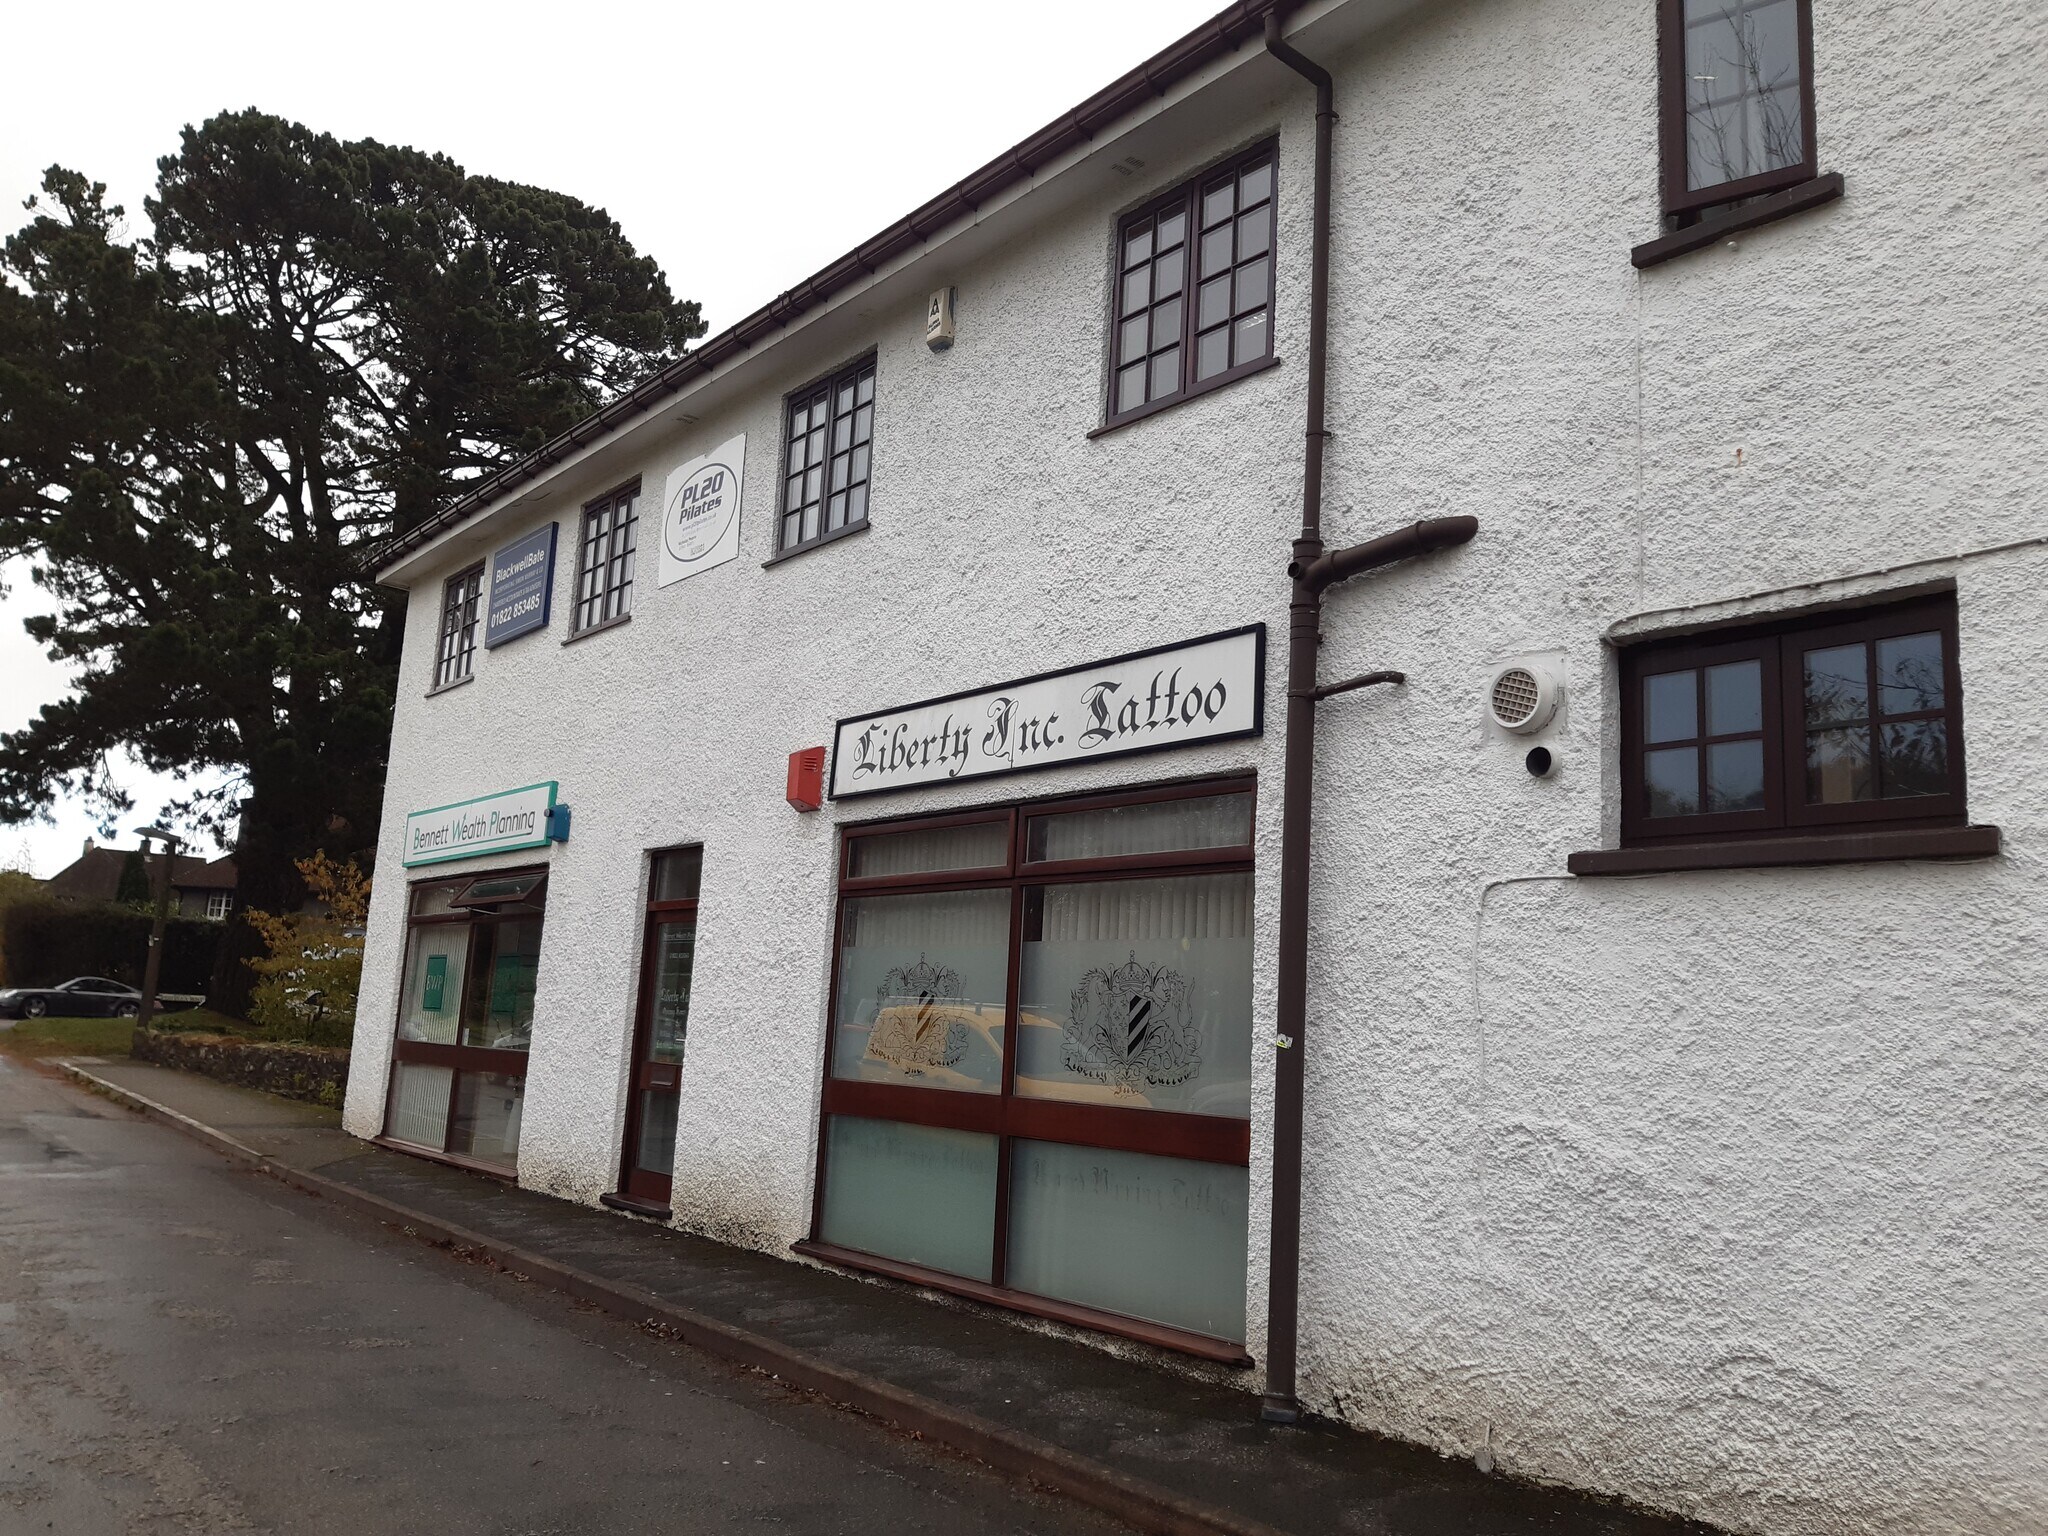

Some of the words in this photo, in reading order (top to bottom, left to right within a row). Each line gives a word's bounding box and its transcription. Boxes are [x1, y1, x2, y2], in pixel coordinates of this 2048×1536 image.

[681, 470, 724, 509] PL20
[679, 495, 722, 525] Pilates
[495, 549, 545, 583] BlackwellBate
[491, 606, 511, 628] 01822
[513, 593, 540, 618] 853485
[852, 713, 972, 780] Liberty
[982, 697, 1063, 768] Inc.
[1078, 666, 1227, 749] Tattoo
[413, 827, 449, 850] Bennett
[451, 813, 487, 842] Wealth
[489, 806, 536, 835] Planning
